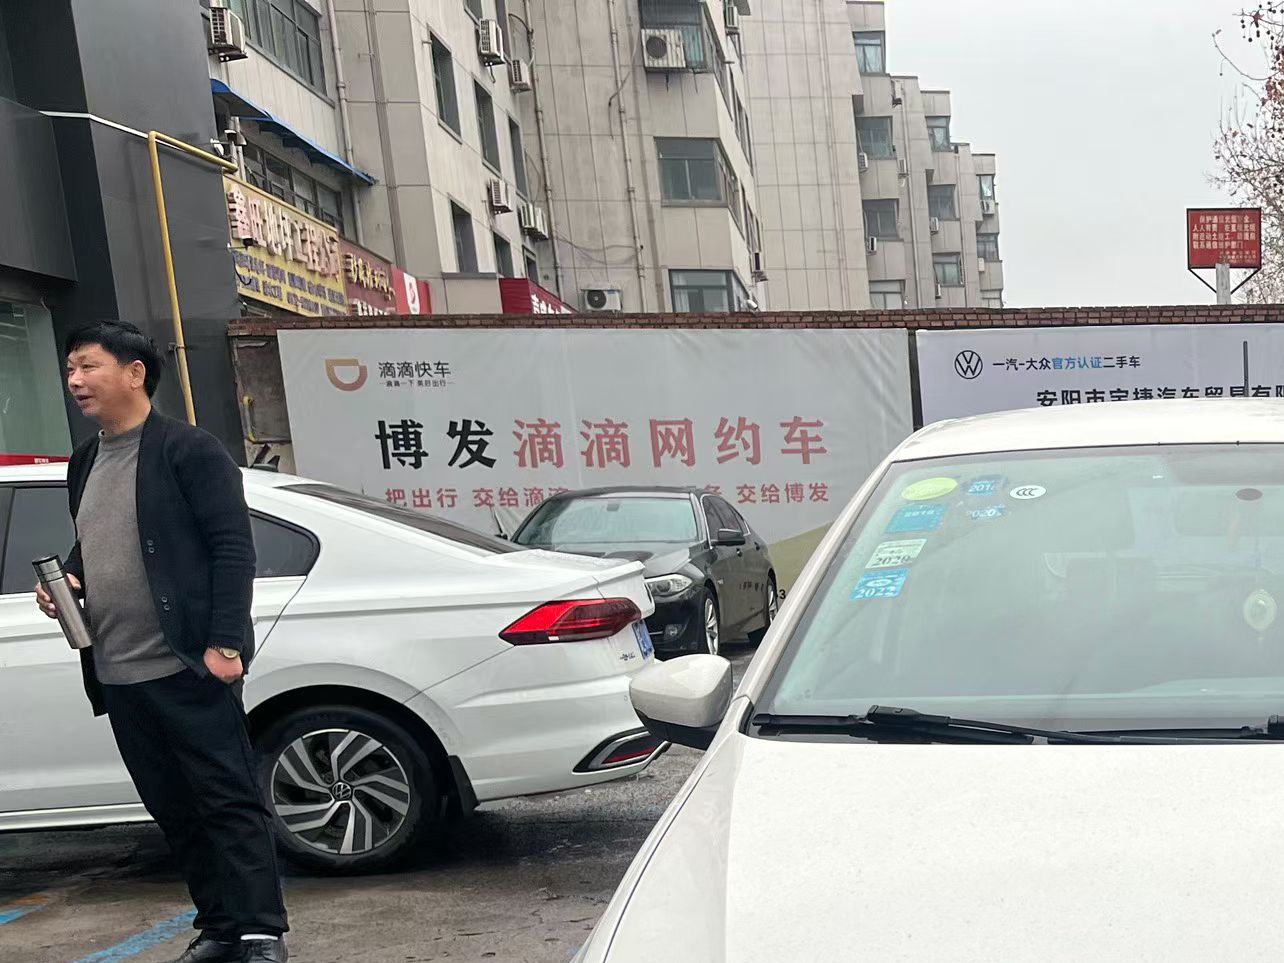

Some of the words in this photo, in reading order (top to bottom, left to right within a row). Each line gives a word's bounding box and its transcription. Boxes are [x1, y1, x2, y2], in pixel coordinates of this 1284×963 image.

[378, 360, 452, 378] 滴滴快车
[375, 416, 828, 470] 博发滴滴网约车
[384, 487, 458, 508] 把出行
[736, 481, 829, 504] 交给博发
